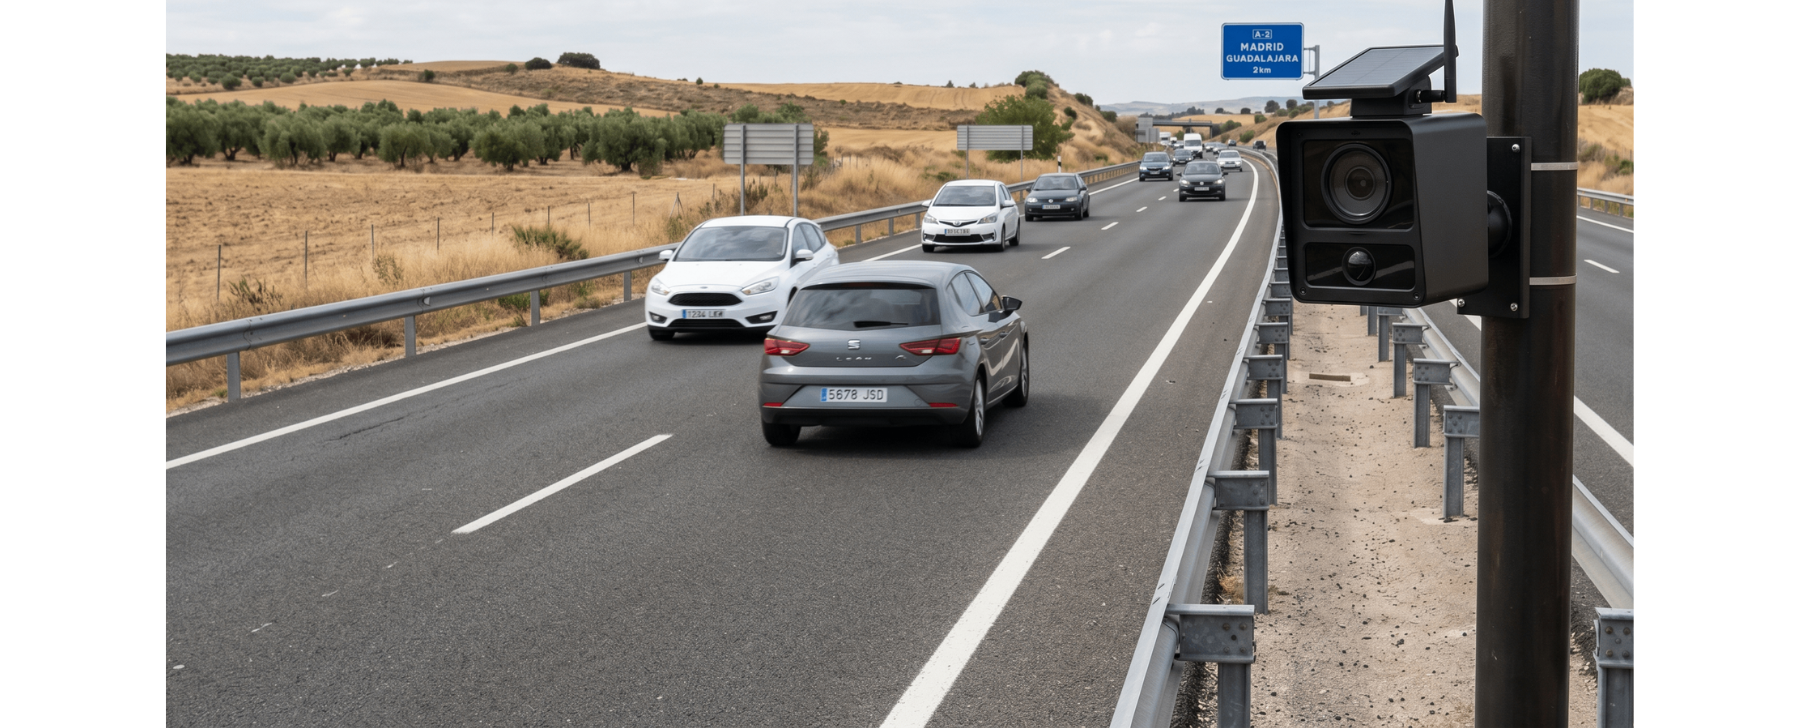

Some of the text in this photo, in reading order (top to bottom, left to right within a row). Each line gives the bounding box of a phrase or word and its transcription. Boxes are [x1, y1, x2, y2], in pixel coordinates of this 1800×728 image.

[1254, 30, 1271, 38] A-2
[1240, 42, 1284, 52] MADRID
[1226, 54, 1299, 62] GUADALAJARA
[829, 389, 884, 400] 5678 JSD
